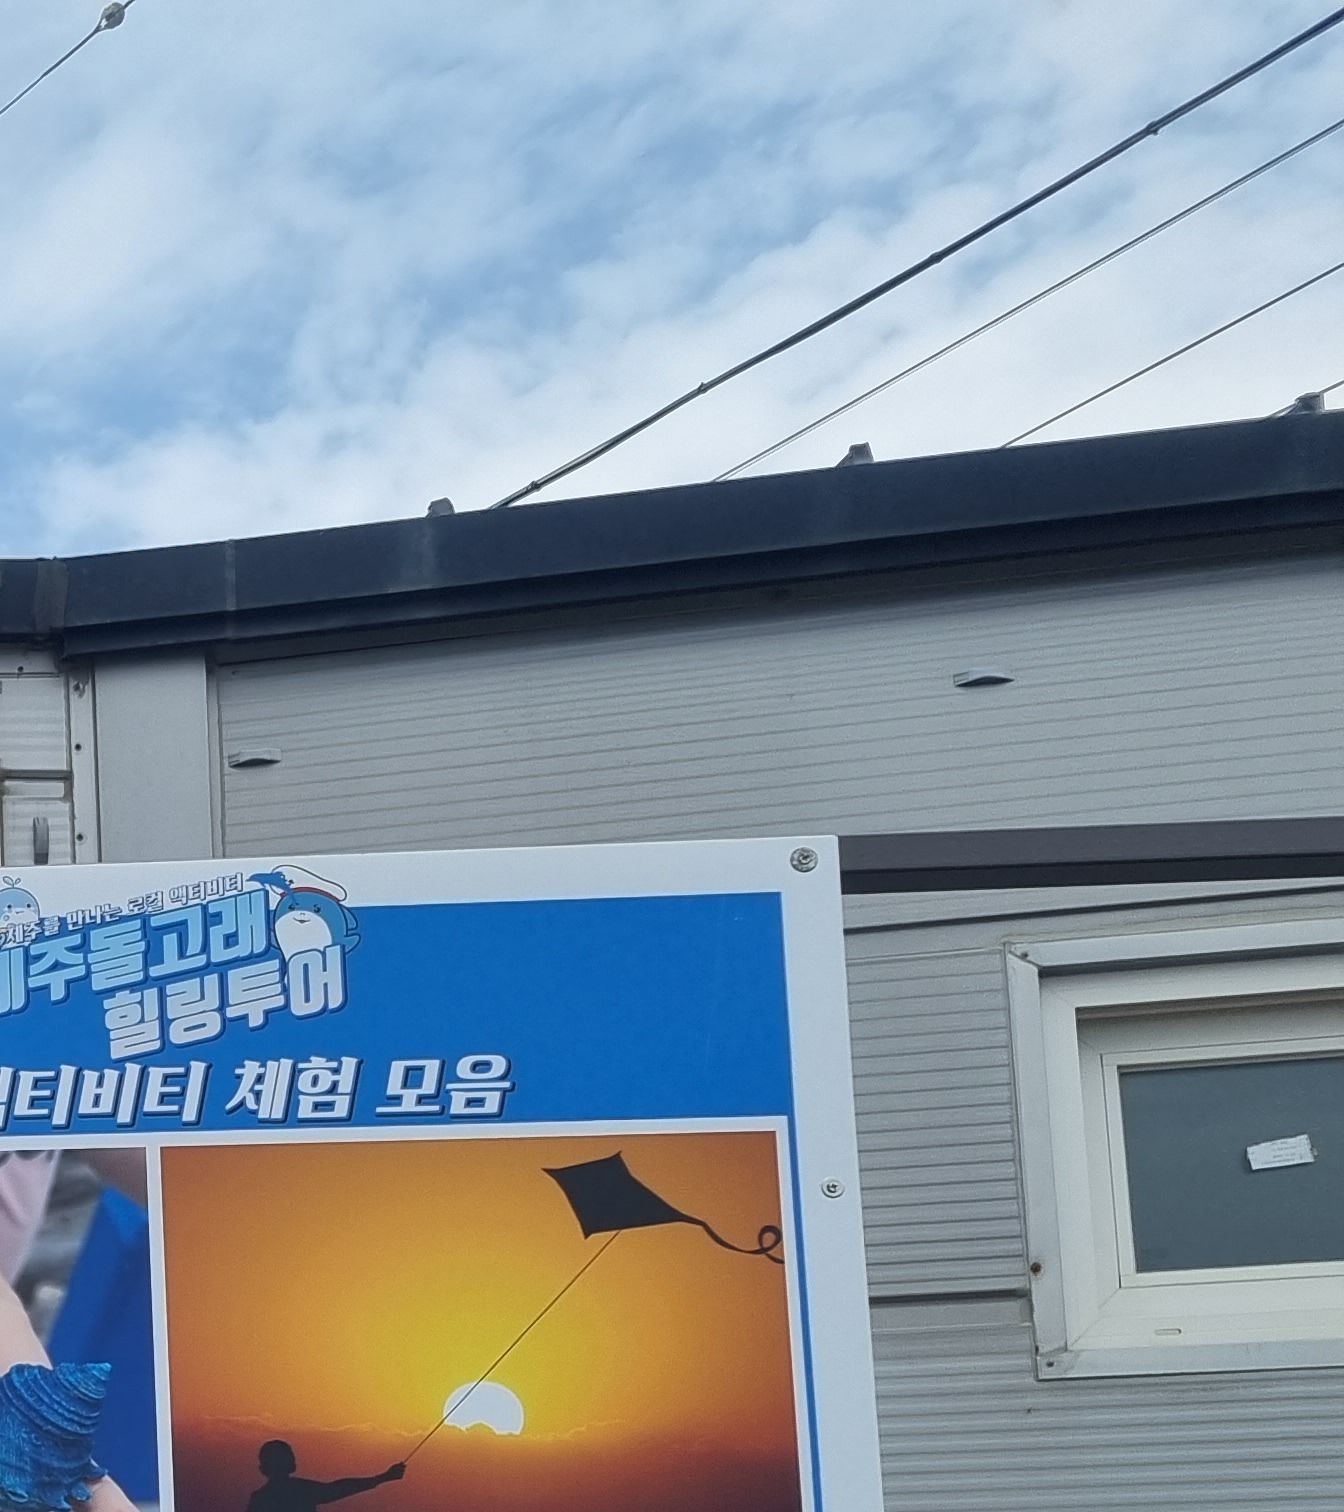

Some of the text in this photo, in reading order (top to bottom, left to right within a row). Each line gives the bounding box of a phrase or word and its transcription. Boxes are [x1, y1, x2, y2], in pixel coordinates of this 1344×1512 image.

[6, 915, 60, 944] 제주를
[66, 904, 122, 930] 만나는
[127, 891, 165, 914] 로컬
[169, 872, 243, 905] 액티비티
[103, 944, 349, 1062] 힐링투어
[226, 1056, 358, 1124] 체험
[376, 1052, 515, 1119] 모음
